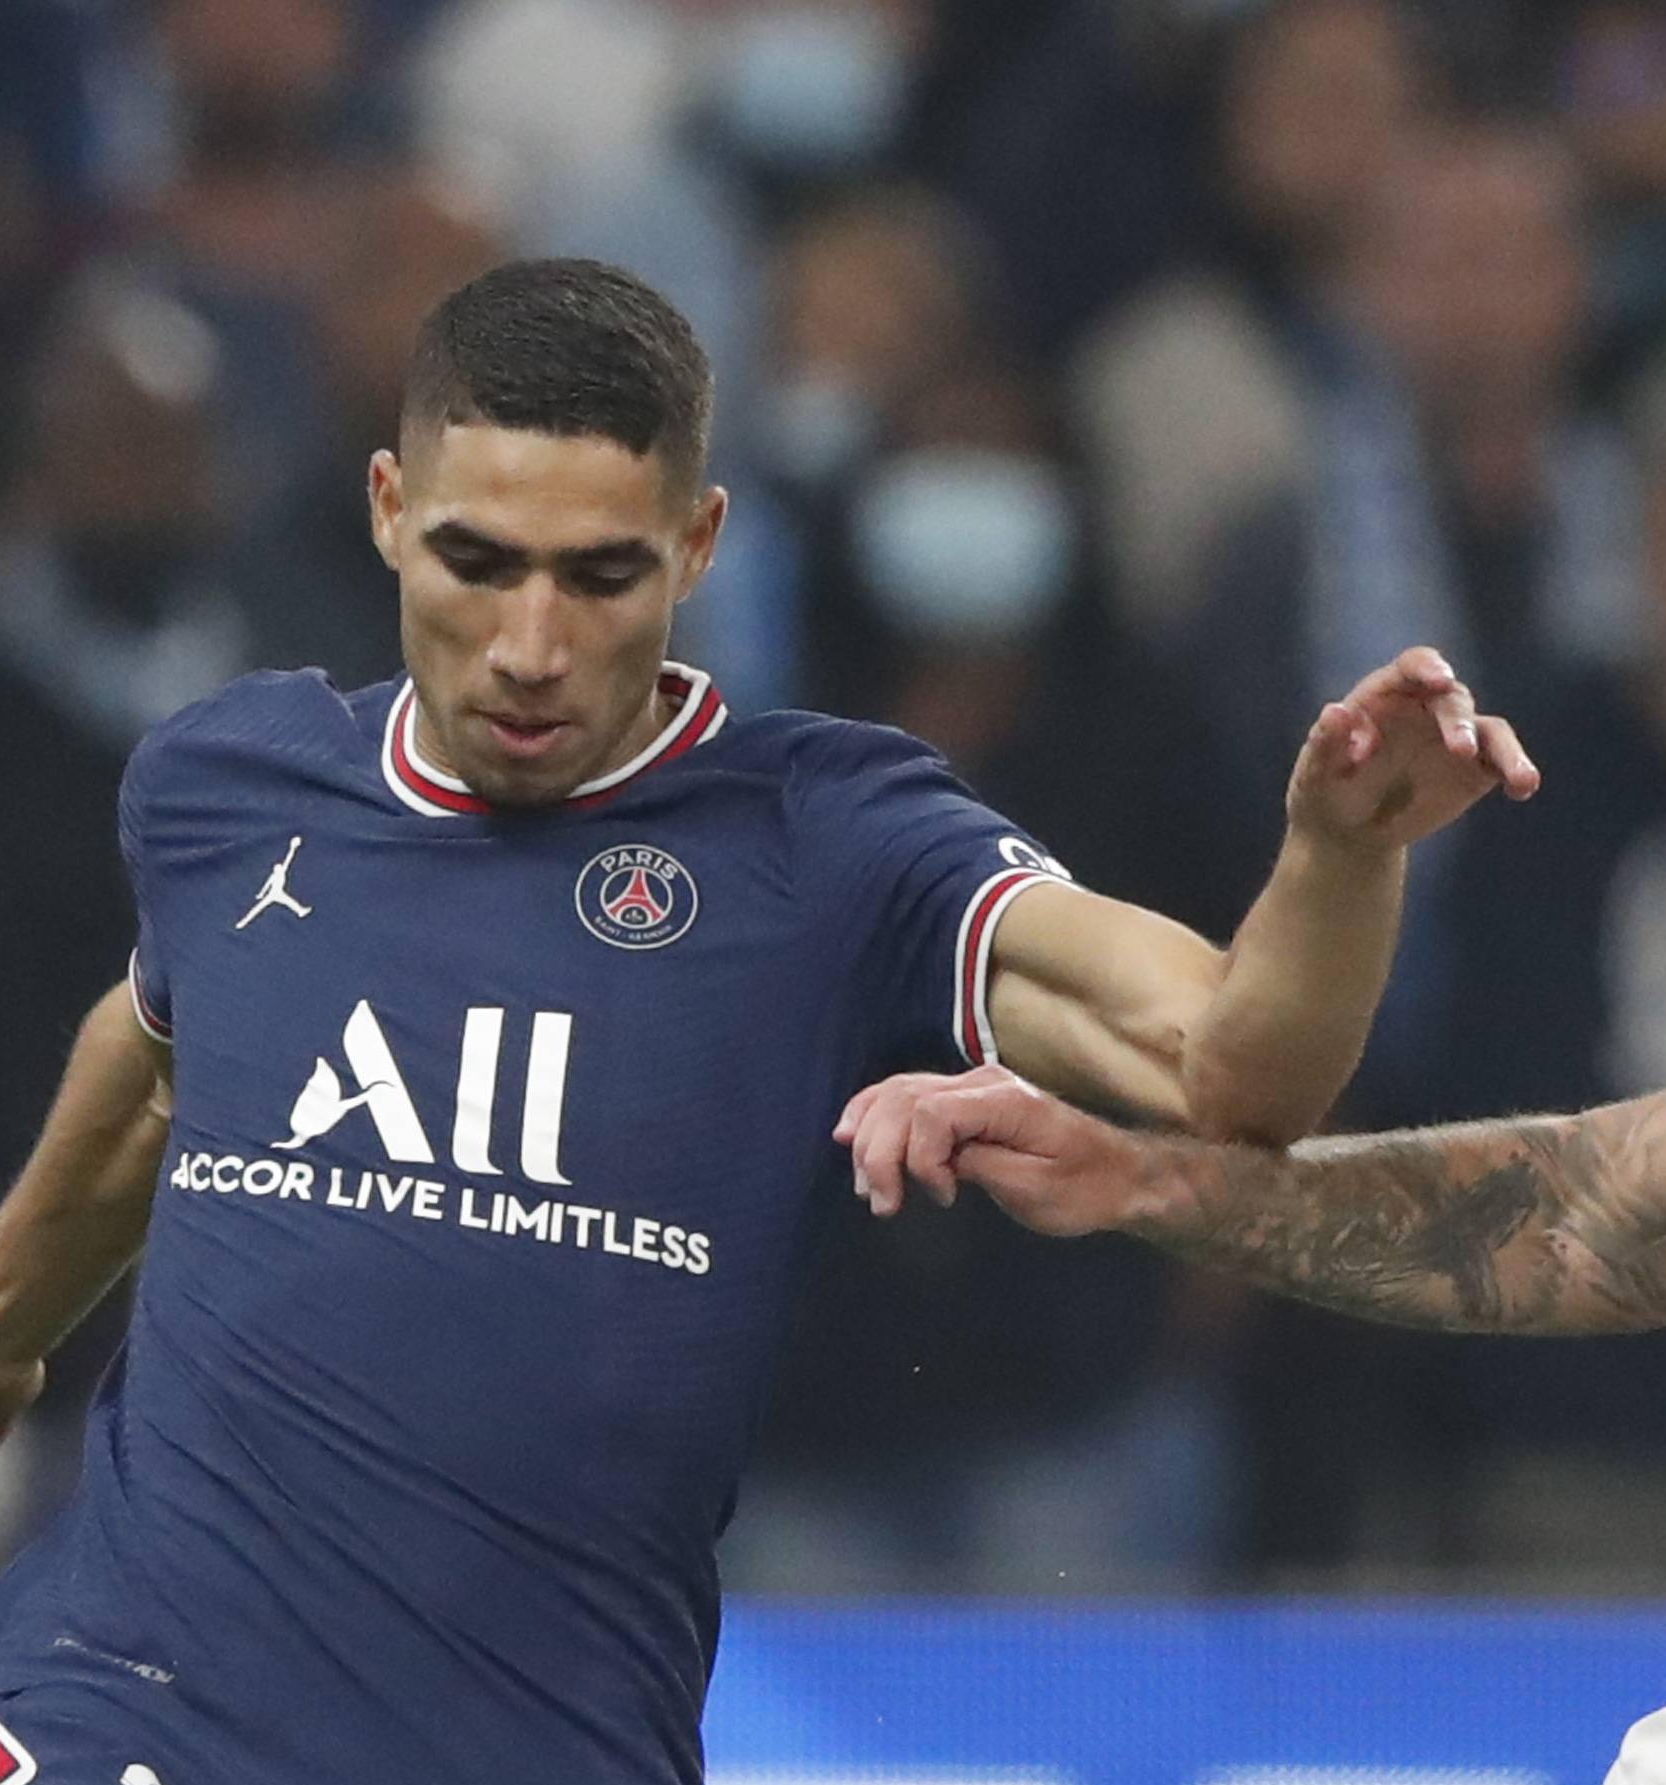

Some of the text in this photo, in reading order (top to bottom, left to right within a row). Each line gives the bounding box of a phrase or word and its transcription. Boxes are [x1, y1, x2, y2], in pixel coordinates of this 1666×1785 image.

[599, 849, 679, 881] PARIS
[170, 1152, 712, 1275] ACCOR LIVE LIMITLESS
